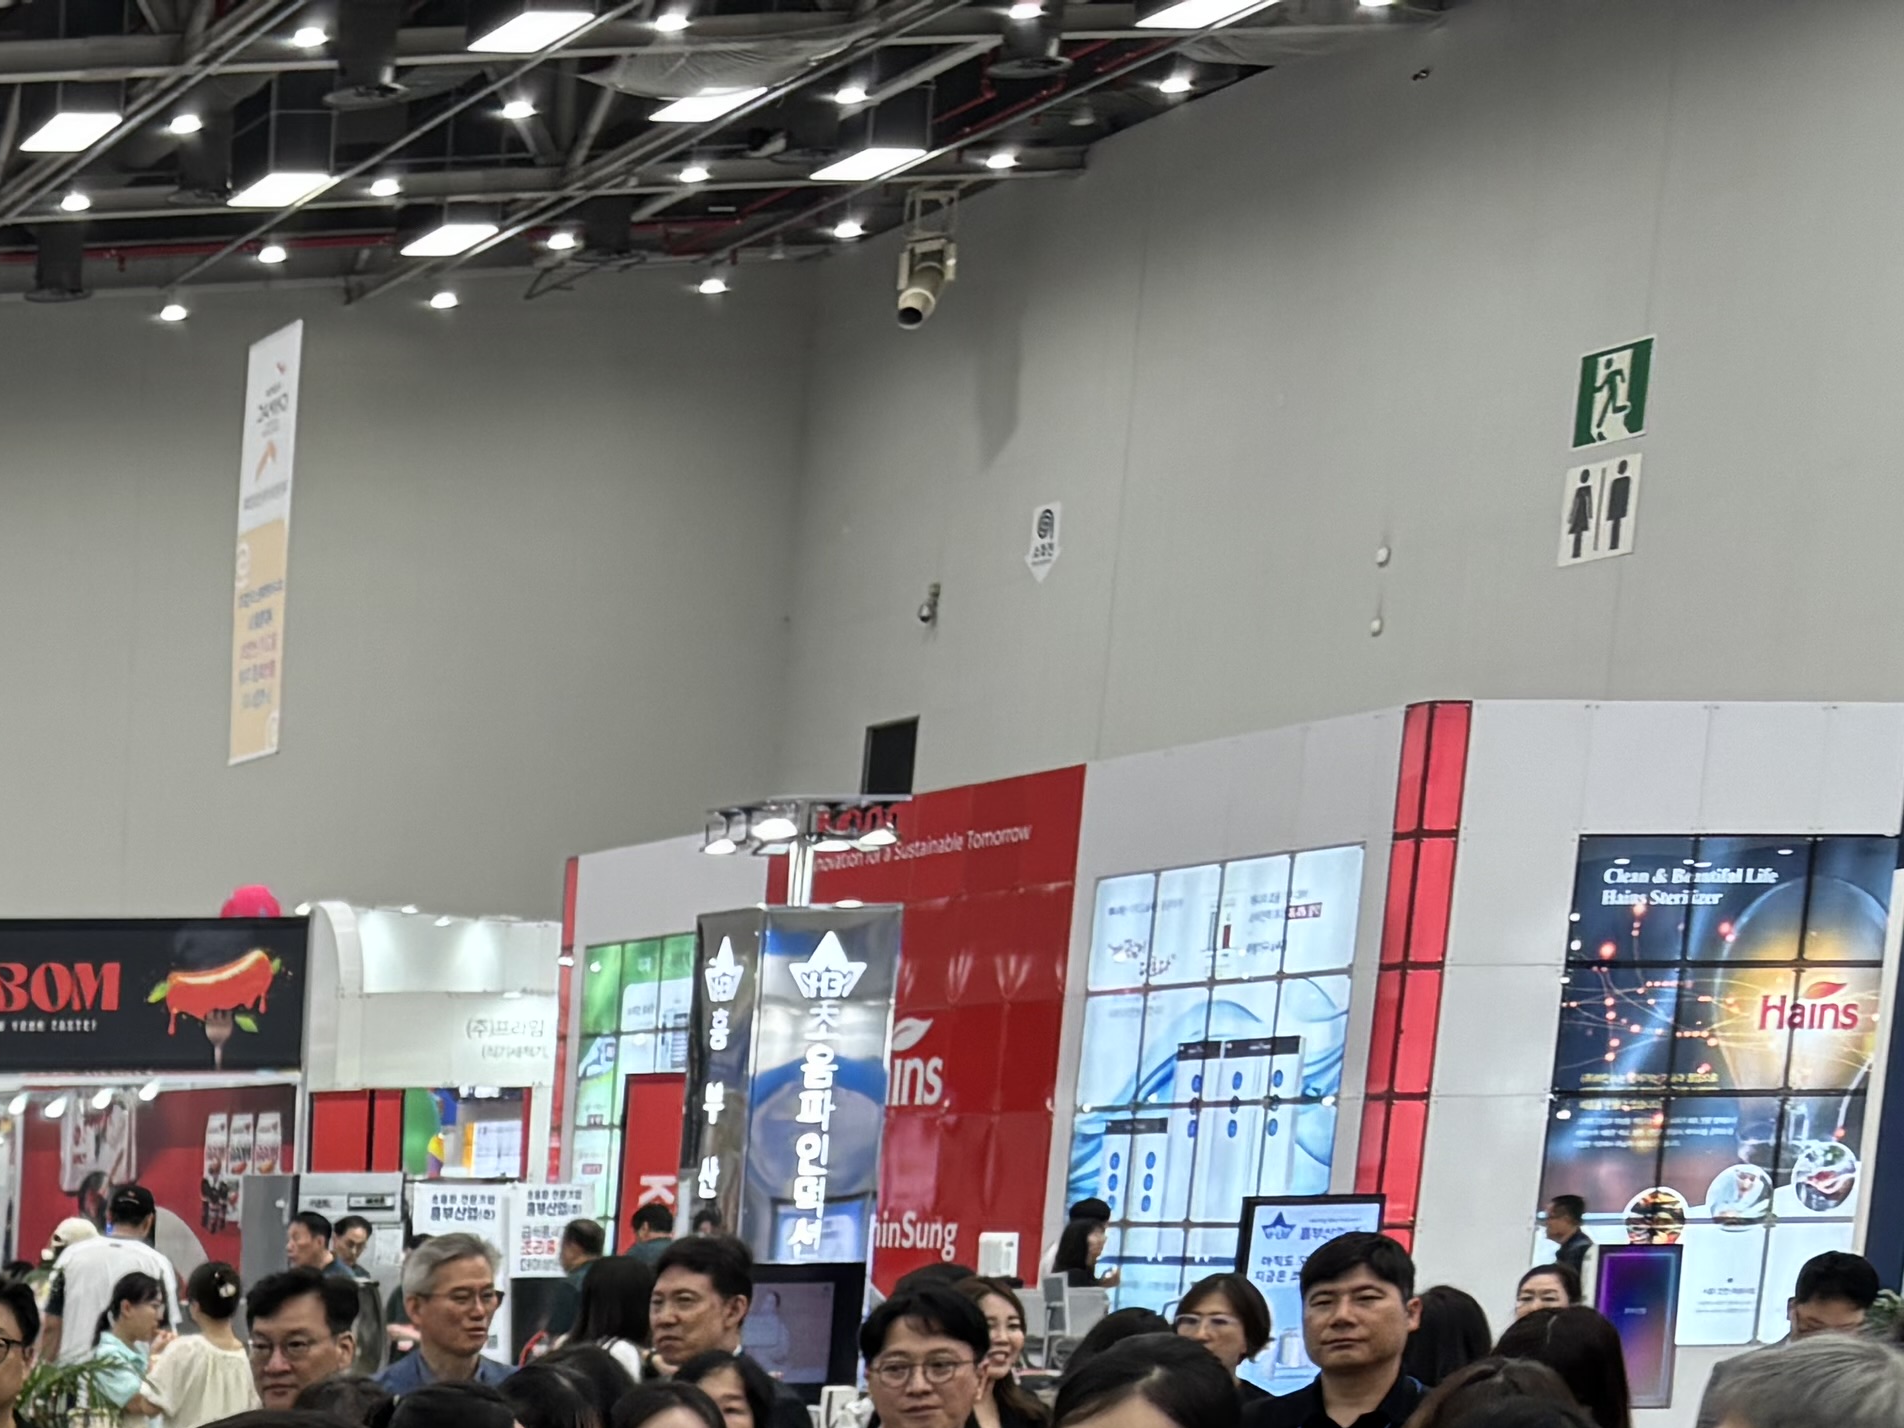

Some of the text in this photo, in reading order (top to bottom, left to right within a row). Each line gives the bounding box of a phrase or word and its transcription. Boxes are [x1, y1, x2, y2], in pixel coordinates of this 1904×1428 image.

[894, 830, 964, 860] Sustainable
[966, 825, 1032, 850] Tomorrow
[1603, 868, 1651, 884] Clean
[1652, 868, 1669, 884] &
[1745, 866, 1780, 884] Life
[1601, 889, 1647, 906] Hains
[1757, 993, 1859, 1032] Hains
[886, 1056, 944, 1105] ins
